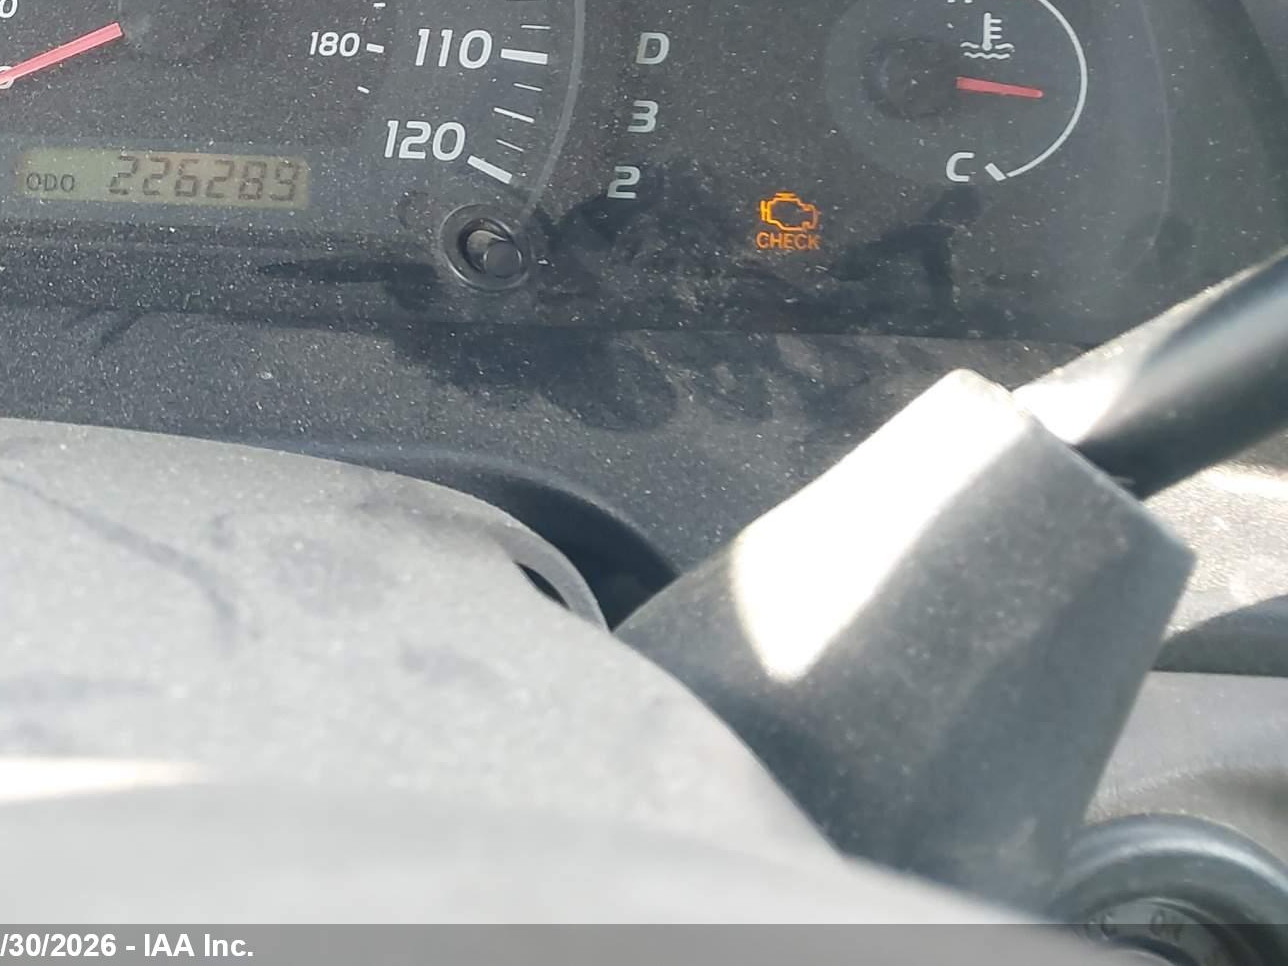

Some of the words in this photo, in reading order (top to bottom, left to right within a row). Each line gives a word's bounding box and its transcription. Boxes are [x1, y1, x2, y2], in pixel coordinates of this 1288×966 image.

[309, 32, 360, 57] 180
[415, 30, 492, 68] 110
[636, 32, 670, 65] D
[627, 100, 658, 132] 3
[385, 121, 466, 160] 120
[27, 174, 75, 194] ODO
[109, 154, 301, 200] 226289
[608, 166, 641, 199] 2
[945, 152, 974, 182] C
[756, 232, 821, 251] CHECK
